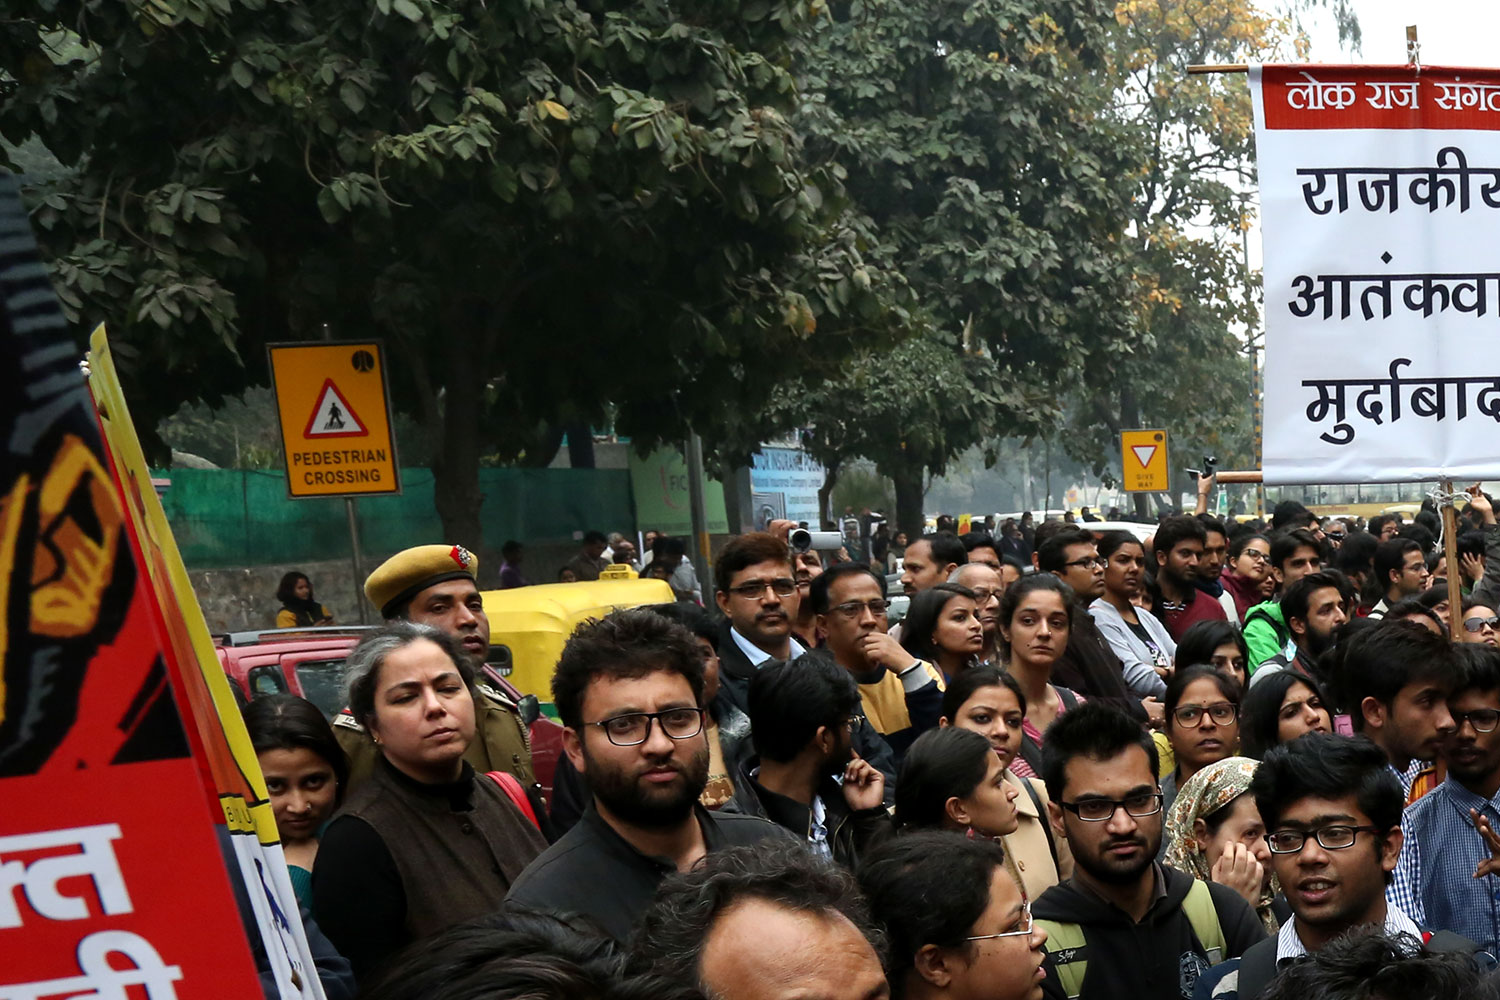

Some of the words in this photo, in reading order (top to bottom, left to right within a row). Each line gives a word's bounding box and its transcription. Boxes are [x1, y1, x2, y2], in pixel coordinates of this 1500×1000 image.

[1287, 73, 1355, 110] लोक
[1366, 82, 1419, 108] राज
[293, 449, 386, 466] PEDESTRIAN
[304, 468, 381, 485] CROSSING
